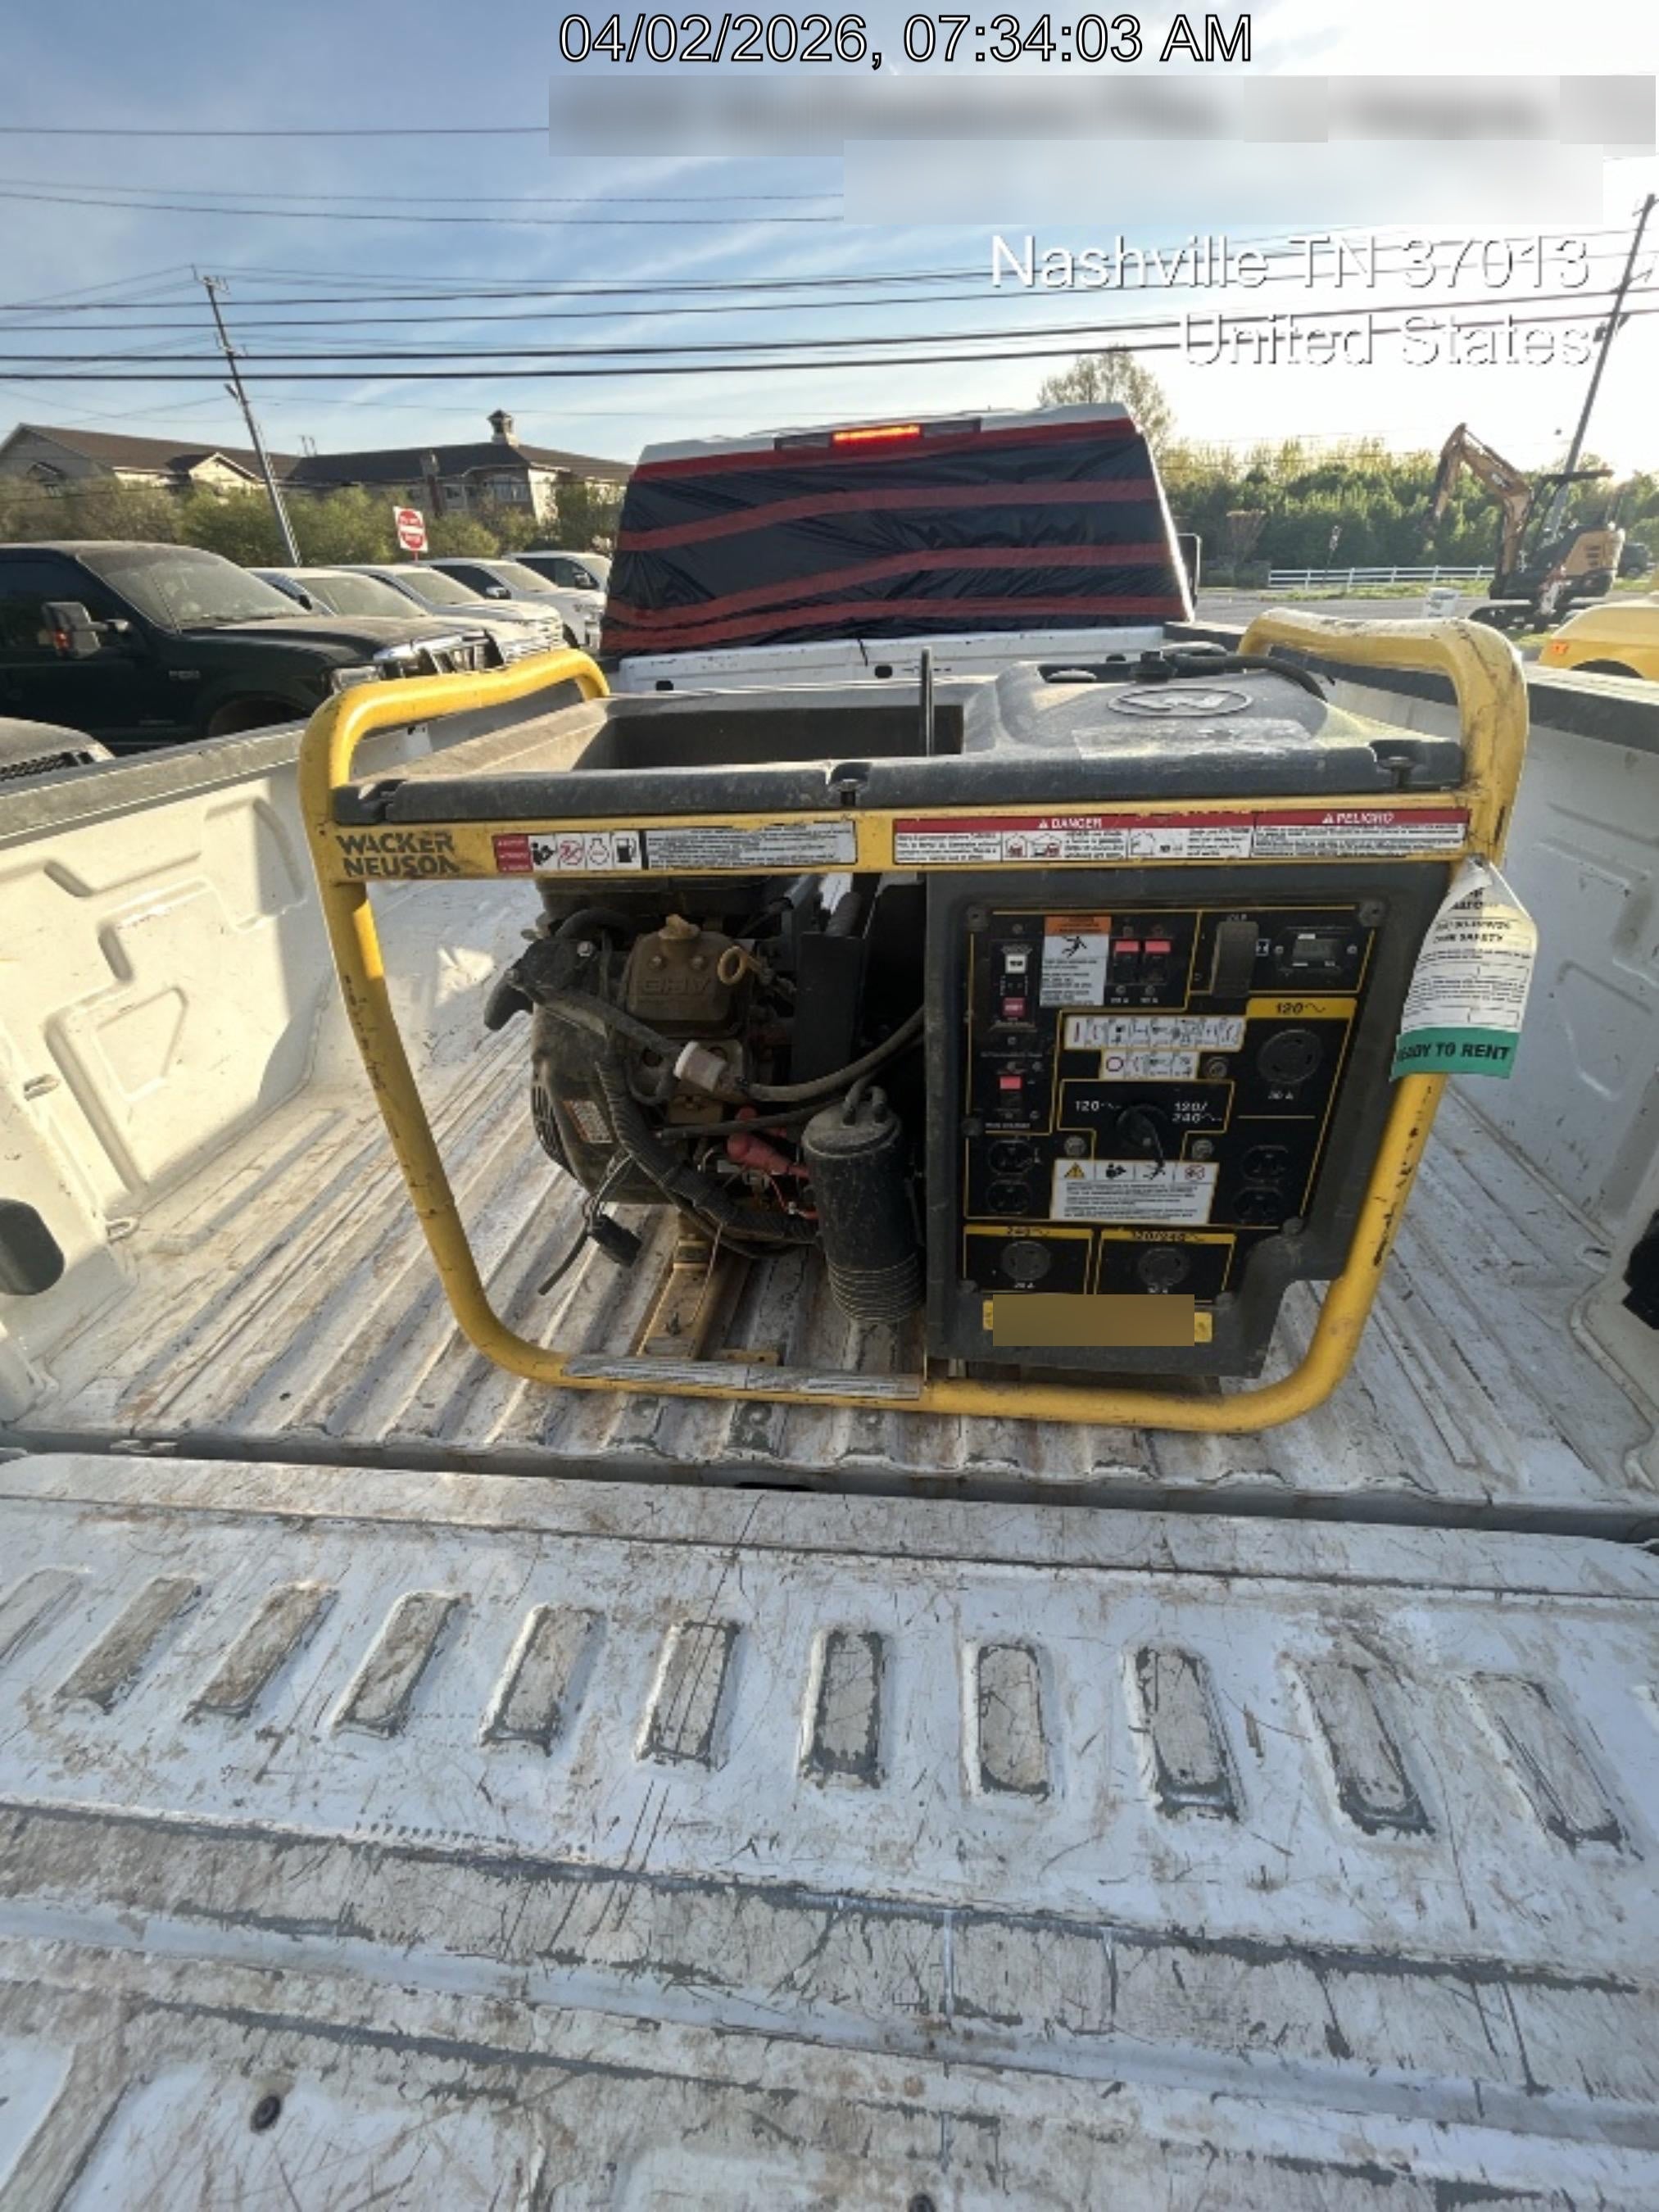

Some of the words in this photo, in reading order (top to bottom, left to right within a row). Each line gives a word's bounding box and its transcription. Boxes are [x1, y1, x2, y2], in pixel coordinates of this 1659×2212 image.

[1051, 818, 1102, 830] DANGER
[1336, 812, 1395, 824] PELIGRO
[336, 831, 455, 854] WACKER
[1276, 1002, 1303, 1015] 120
[1435, 1042, 1456, 1058] TO
[1460, 1044, 1510, 1060] RENT
[1075, 1100, 1099, 1112] 120
